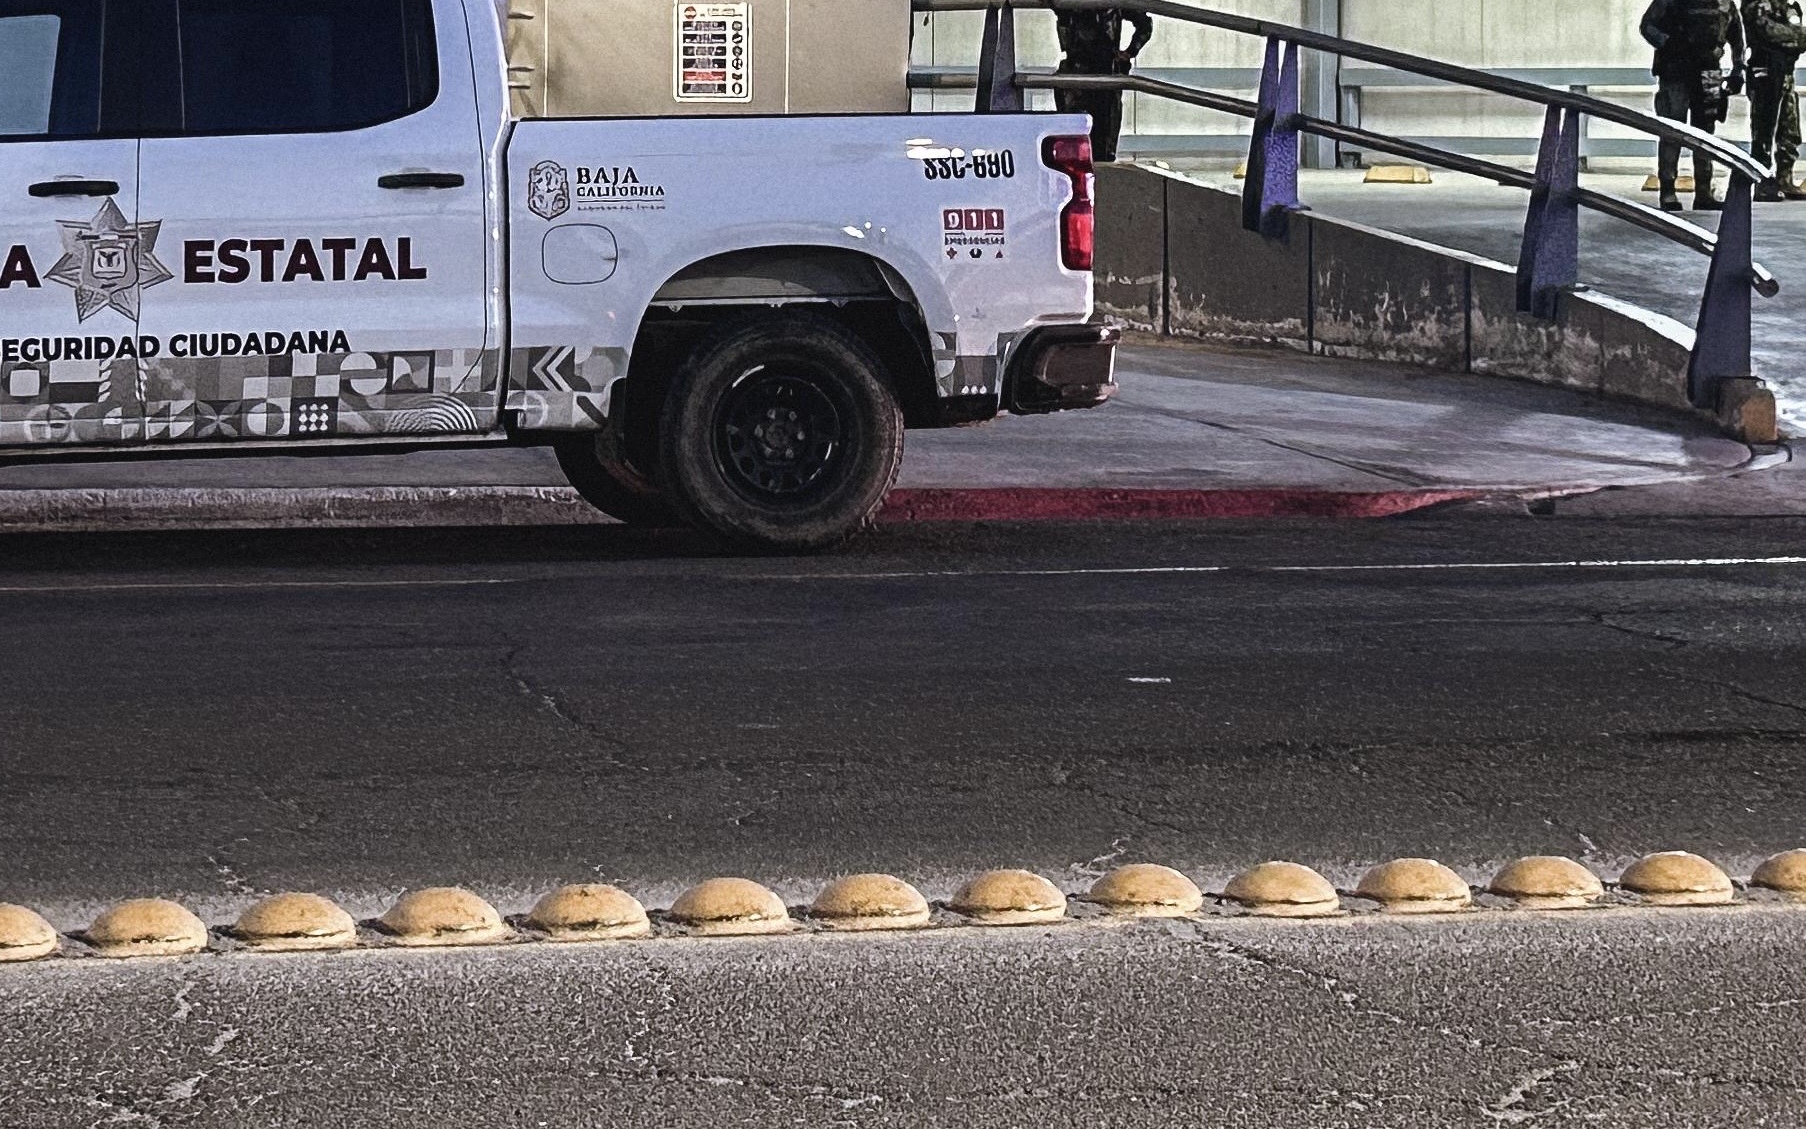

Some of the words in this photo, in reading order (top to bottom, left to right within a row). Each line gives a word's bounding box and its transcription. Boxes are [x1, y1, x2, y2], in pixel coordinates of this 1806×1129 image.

[576, 167, 639, 185] BAJA
[183, 237, 428, 283] ESTATAL
[0, 335, 161, 362] EGURIDAD
[169, 330, 351, 357] CIUDADANA
